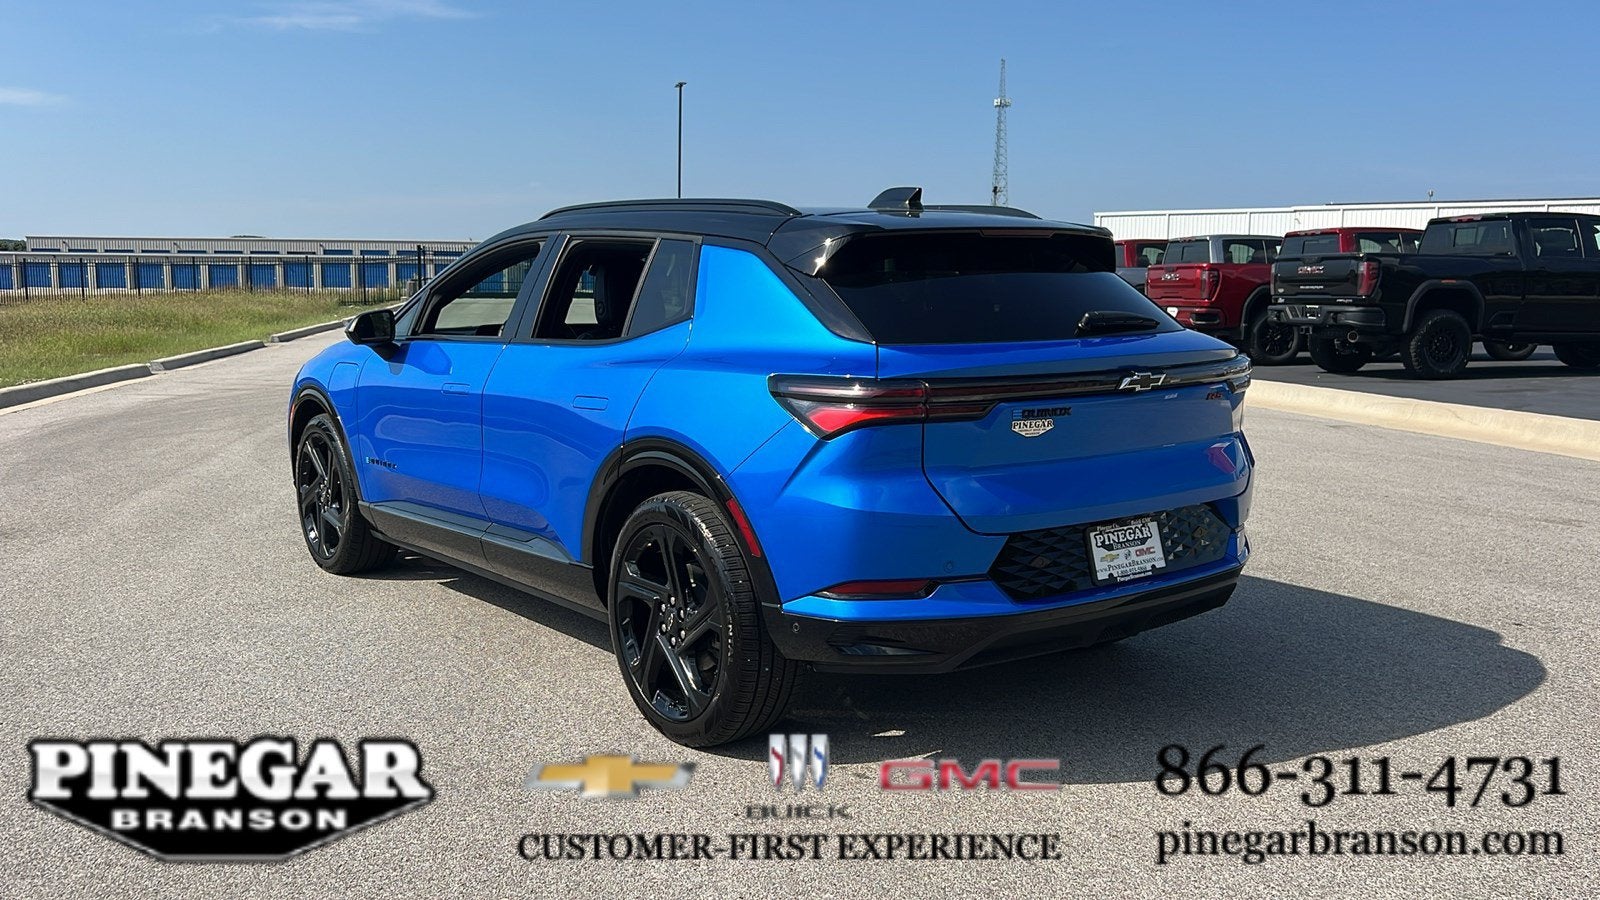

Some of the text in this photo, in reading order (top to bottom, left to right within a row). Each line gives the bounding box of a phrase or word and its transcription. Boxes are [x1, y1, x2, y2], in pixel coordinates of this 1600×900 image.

[1013, 420, 1053, 430] PINEGAR
[1095, 526, 1152, 547] PINEGAR
[1135, 546, 1156, 558] GMC
